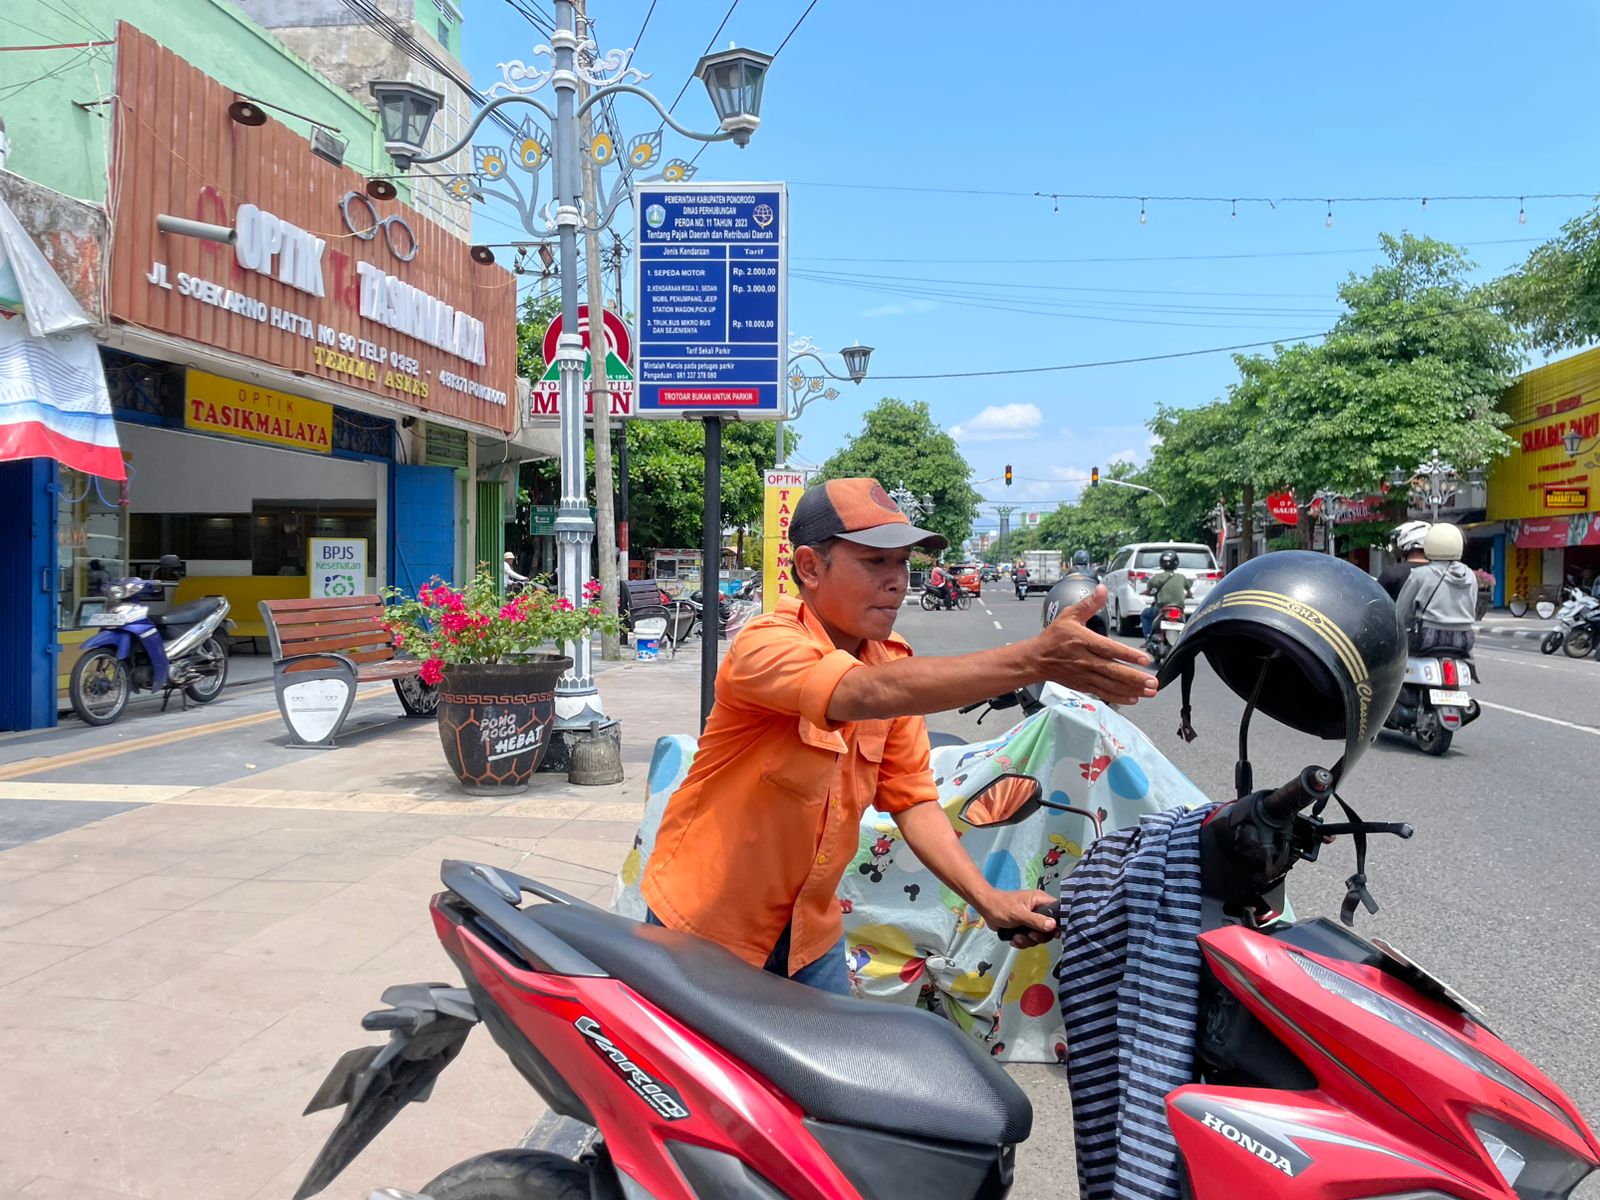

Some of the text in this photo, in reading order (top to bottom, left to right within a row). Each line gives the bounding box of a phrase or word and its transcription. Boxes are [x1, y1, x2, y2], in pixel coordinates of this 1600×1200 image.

[664, 195, 756, 204] PEMERINTAH KABUPATEN PONOROGO
[683, 206, 737, 215] DINAS PERHUBUNGAN
[674, 218, 694, 227] PERDA
[706, 218, 713, 227] 11
[713, 218, 733, 227] TAHUN
[735, 218, 748, 227] 2023
[647, 230, 773, 240] Tentang Pajak Daerah dan Retribusi Daerah
[236, 203, 326, 298] OPTIK
[663, 247, 710, 256] Jenis Kendaraan
[732, 267, 776, 277] Rp. 2.000,00
[732, 284, 776, 294] Rp. 3.000,00
[652, 295, 669, 303] MOBIL
[704, 295, 718, 303] JEEP
[177, 271, 268, 323] SOEKARNO
[271, 306, 315, 340] HATTA
[317, 323, 336, 347] NO
[358, 338, 387, 364] TELP
[389, 351, 420, 377] 0352
[732, 320, 774, 329] Rp. 10.000,00
[686, 347, 731, 355] Tarif Sekali Parkir
[643, 362, 735, 371] Mintalah Karcis pada petugas parkir
[313, 346, 430, 398] TERIMA ASKES
[643, 371, 673, 380] Pengaduan
[238, 389, 295, 413] OPTIK
[664, 392, 753, 400] TROTOAR BUKAN UNTUK PARKIR
[190, 399, 329, 446] TASIKMALAYA
[767, 474, 802, 485] OPTIK
[323, 545, 354, 560] BPJS
[315, 561, 361, 570] Kesehatan
[494, 725, 545, 753] HEBAT
[1201, 1111, 1294, 1177] HONDA
